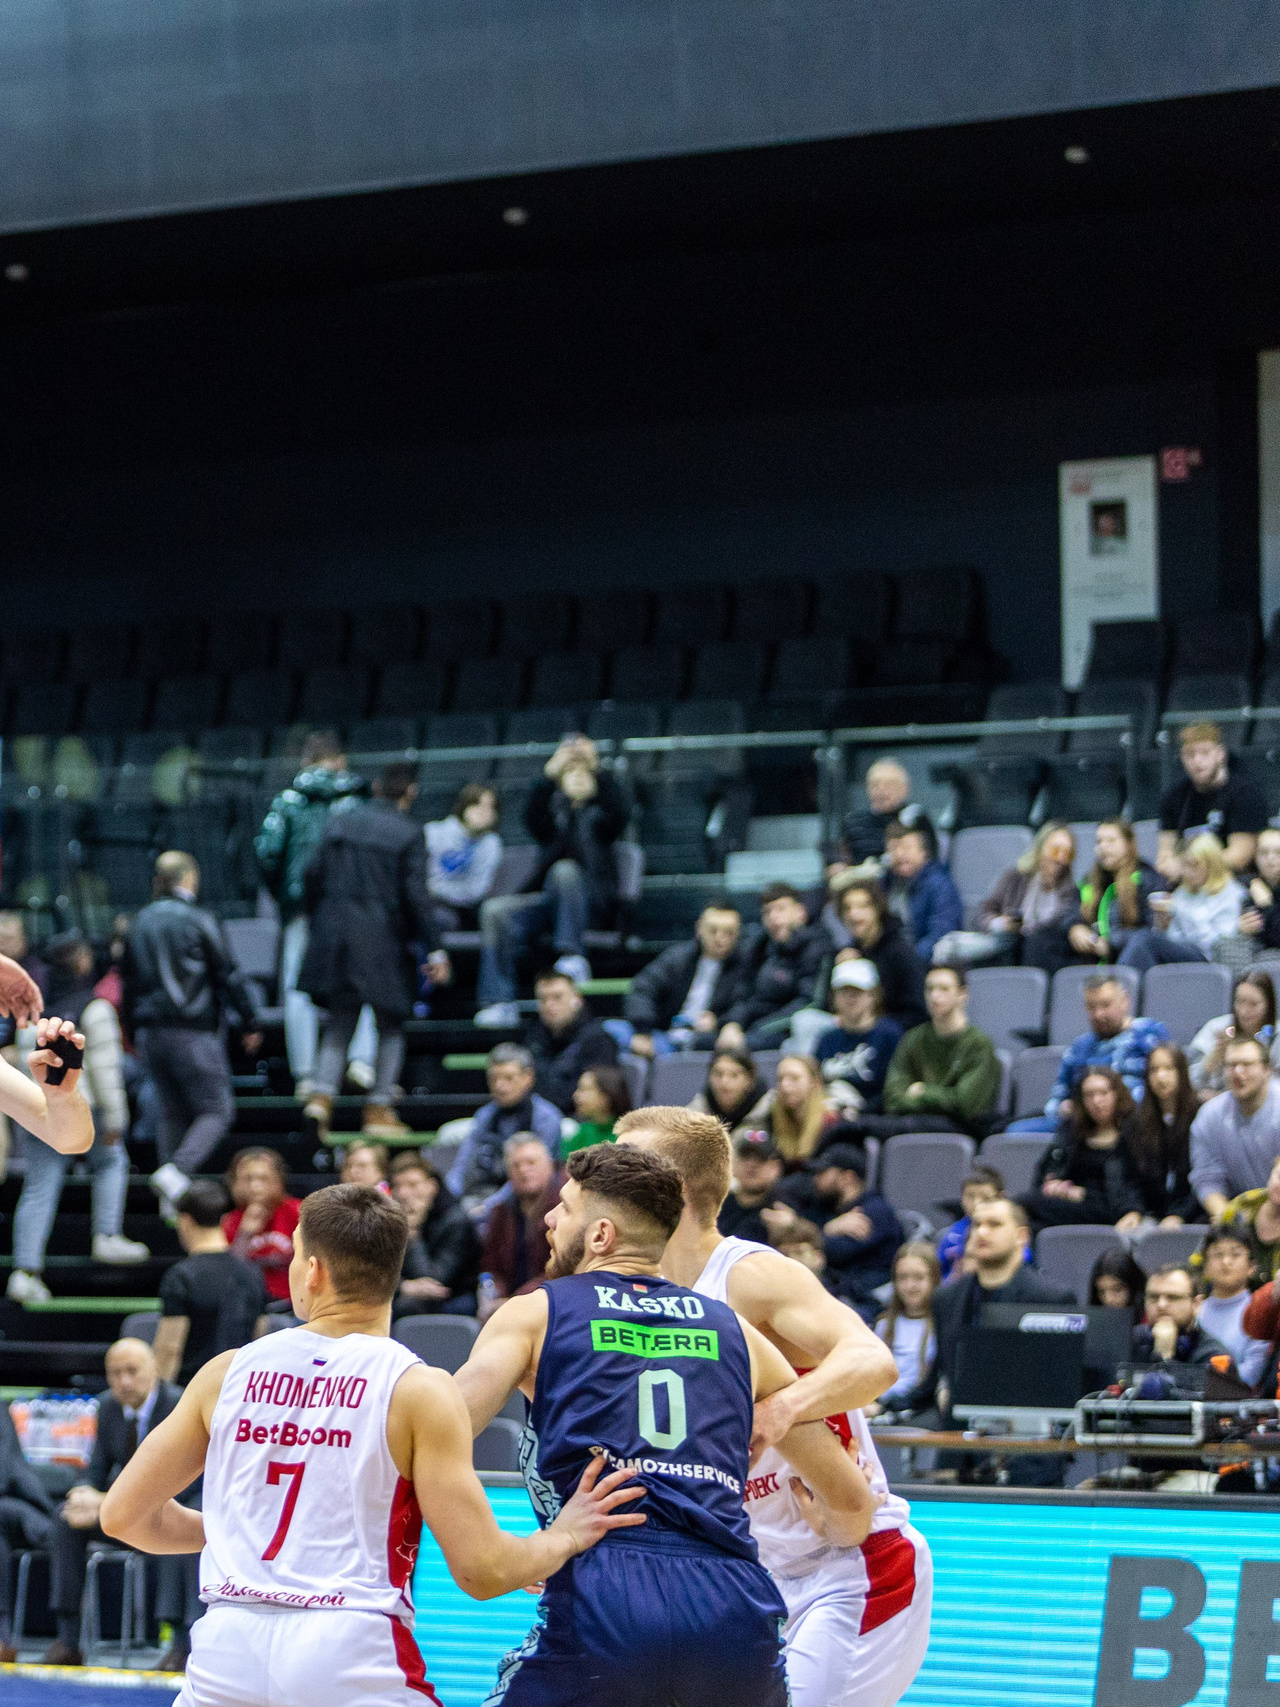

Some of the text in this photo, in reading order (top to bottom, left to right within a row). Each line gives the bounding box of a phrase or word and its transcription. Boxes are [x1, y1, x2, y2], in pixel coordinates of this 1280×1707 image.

[594, 1285, 705, 1319] KASKO
[243, 1371, 368, 1409] KHOMENKO
[638, 1368, 688, 1450] 0
[234, 1419, 352, 1448] BetBoom
[261, 1461, 306, 1561] 7
